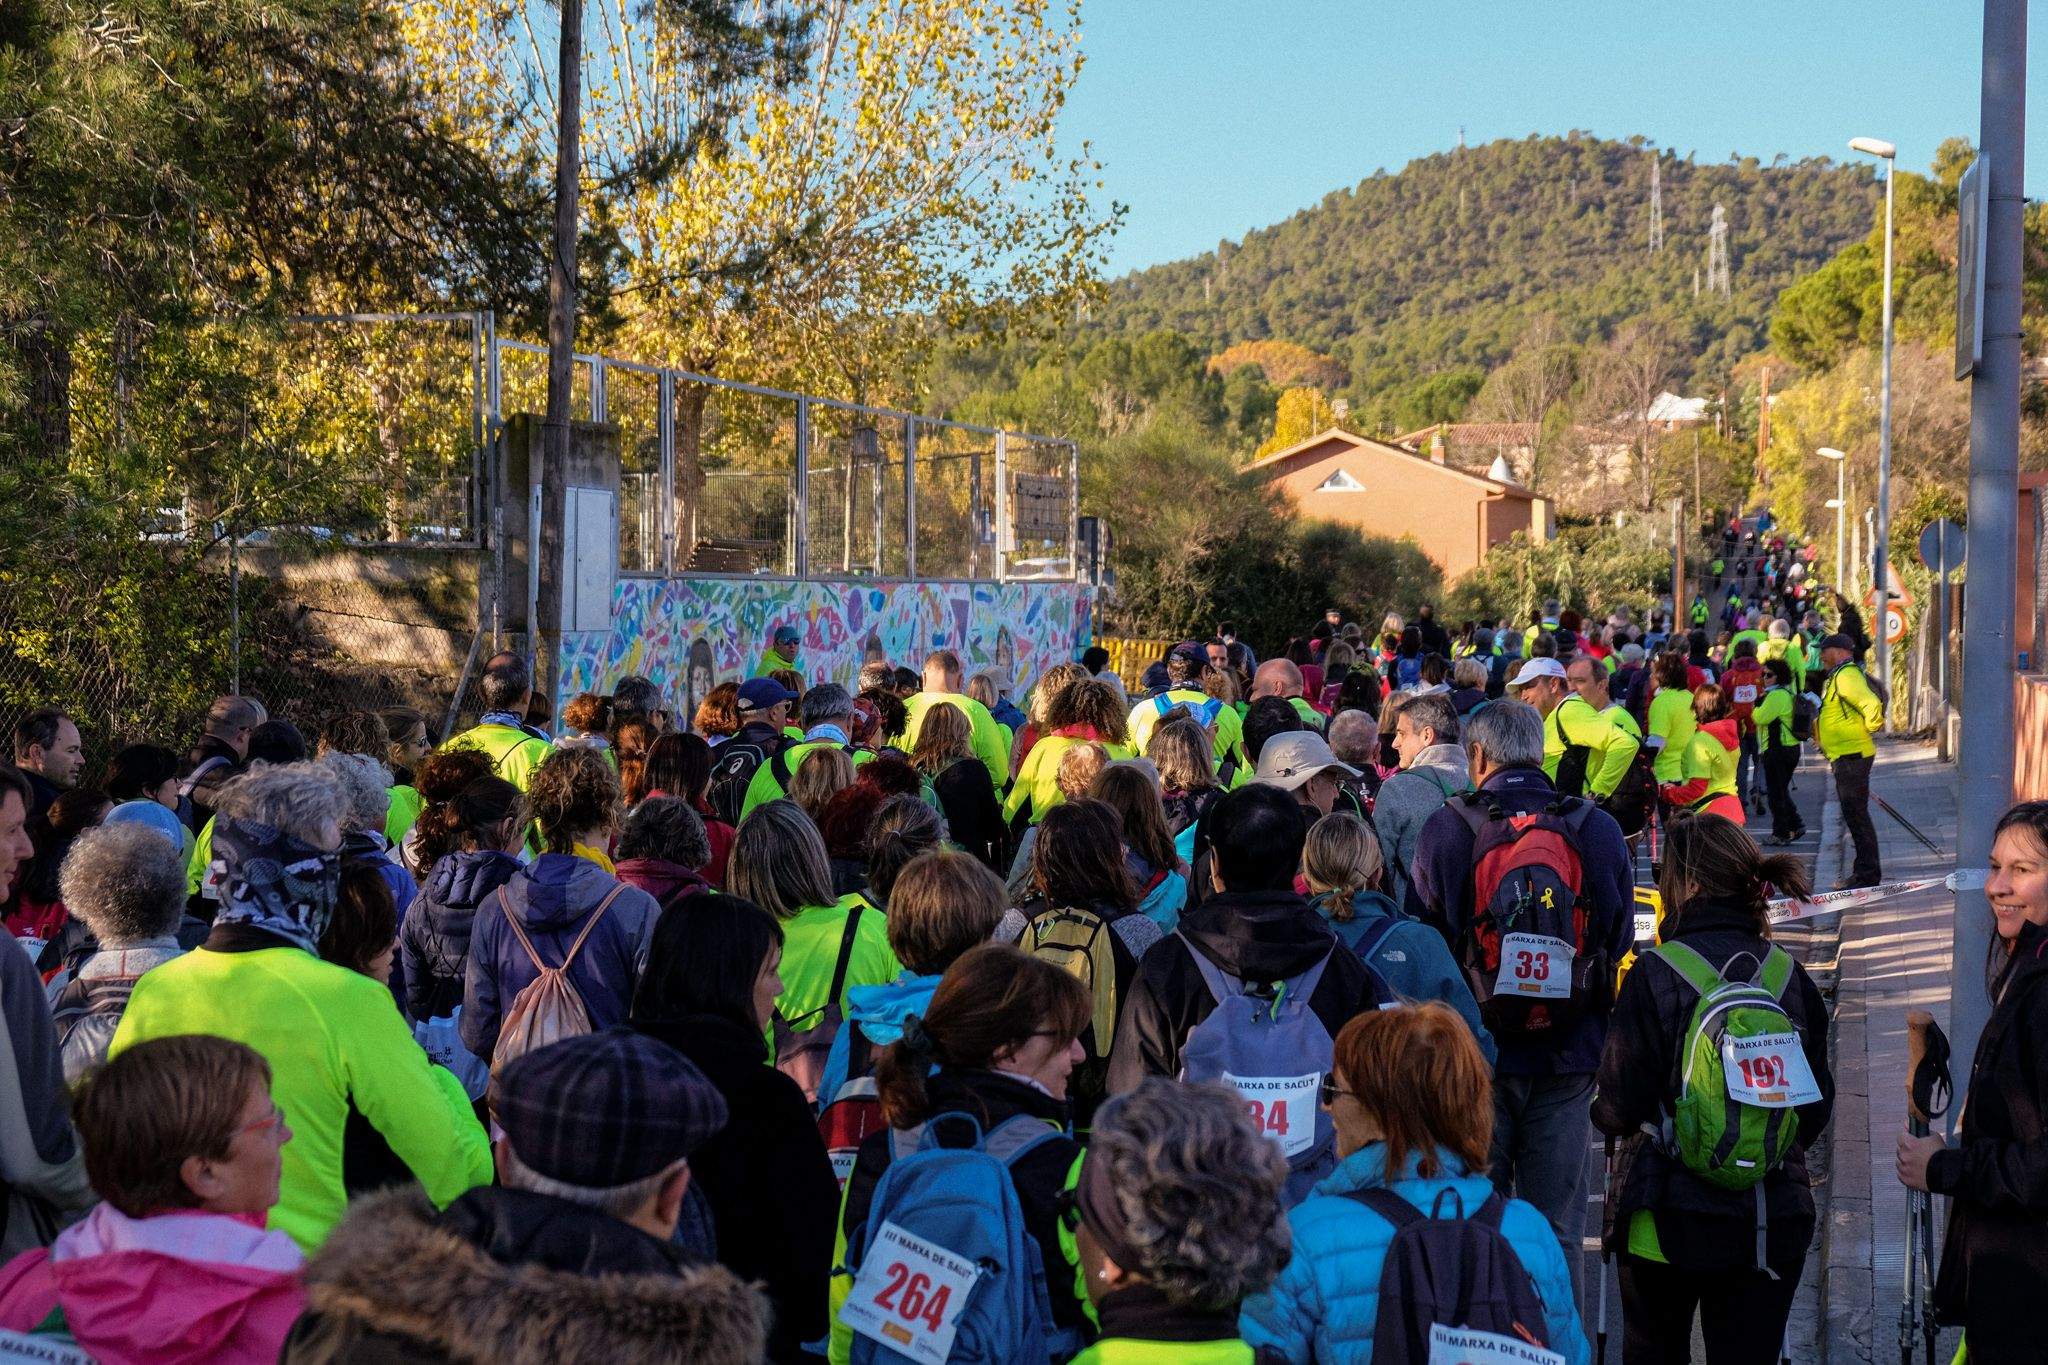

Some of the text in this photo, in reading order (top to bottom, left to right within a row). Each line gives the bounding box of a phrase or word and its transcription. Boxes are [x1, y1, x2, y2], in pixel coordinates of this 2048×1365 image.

[1511, 936, 1536, 944] MARXA
[1515, 950, 1549, 981] 33
[1734, 1040, 1762, 1050] MARXA
[1763, 1039, 1773, 1047] DE
[1774, 1037, 1796, 1046] SALUT
[1267, 1082, 1281, 1090] DE
[1284, 1078, 1315, 1090] SALUT
[1738, 1055, 1790, 1089] 192
[885, 1230, 973, 1281] III MARXA DE SALUT
[873, 1262, 952, 1334] 264
[0, 1340, 57, 1361] MARXA
[1435, 1331, 1447, 1342] III
[1448, 1335, 1496, 1351] MARXA
[1500, 1343, 1517, 1356] DE
